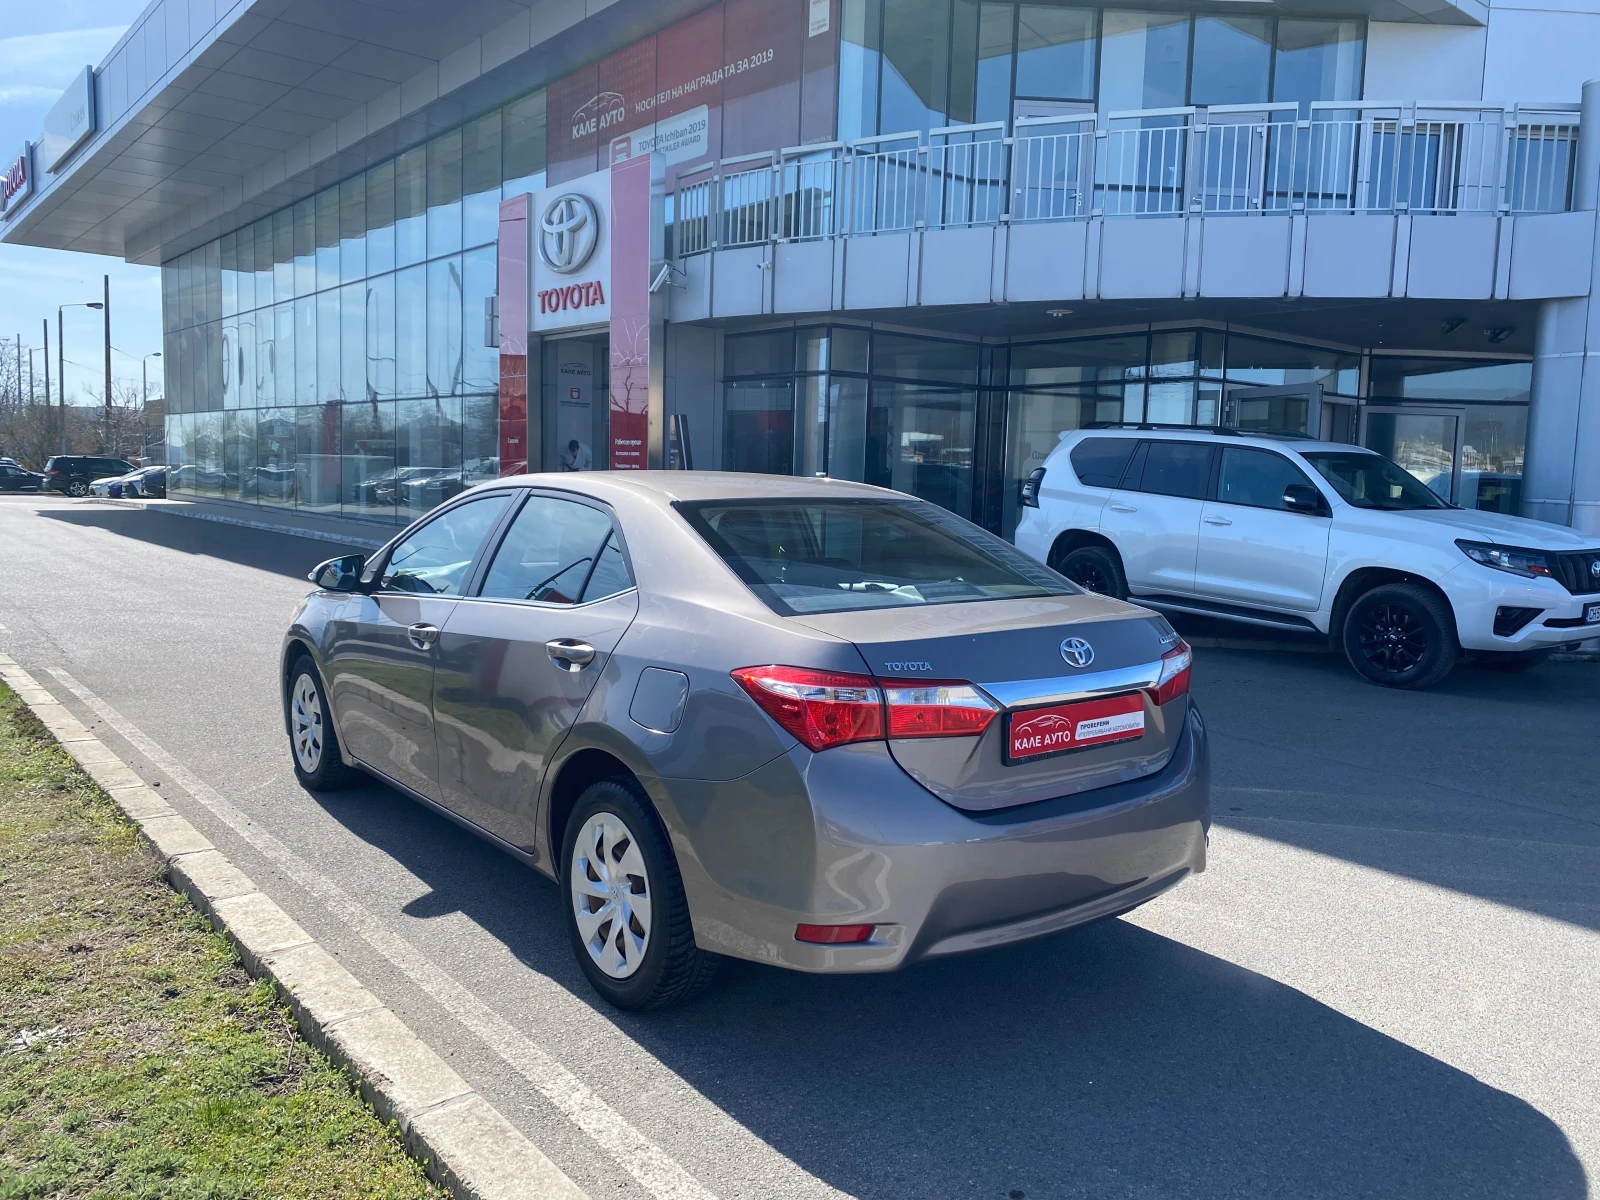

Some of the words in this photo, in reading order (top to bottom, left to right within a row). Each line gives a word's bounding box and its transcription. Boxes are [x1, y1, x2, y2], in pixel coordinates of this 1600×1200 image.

[635, 89, 671, 114] НОСИТЕЛ
[671, 85, 684, 100] НА
[736, 58, 749, 74] ЗА
[750, 48, 774, 68] 2019
[572, 117, 597, 140] КАЛЕ
[599, 106, 625, 130] АУТО
[638, 134, 664, 152] TOYOTA
[664, 127, 688, 144] Ichiban
[688, 119, 706, 135] 2019
[680, 134, 701, 147] AWARD
[537, 280, 605, 315] TOYOTA
[884, 660, 933, 671] TOYOTA
[1080, 719, 1110, 731] ПРОВЕРЕНИ
[1014, 735, 1042, 751] КАЛЕ
[1043, 730, 1071, 746] АУТО
